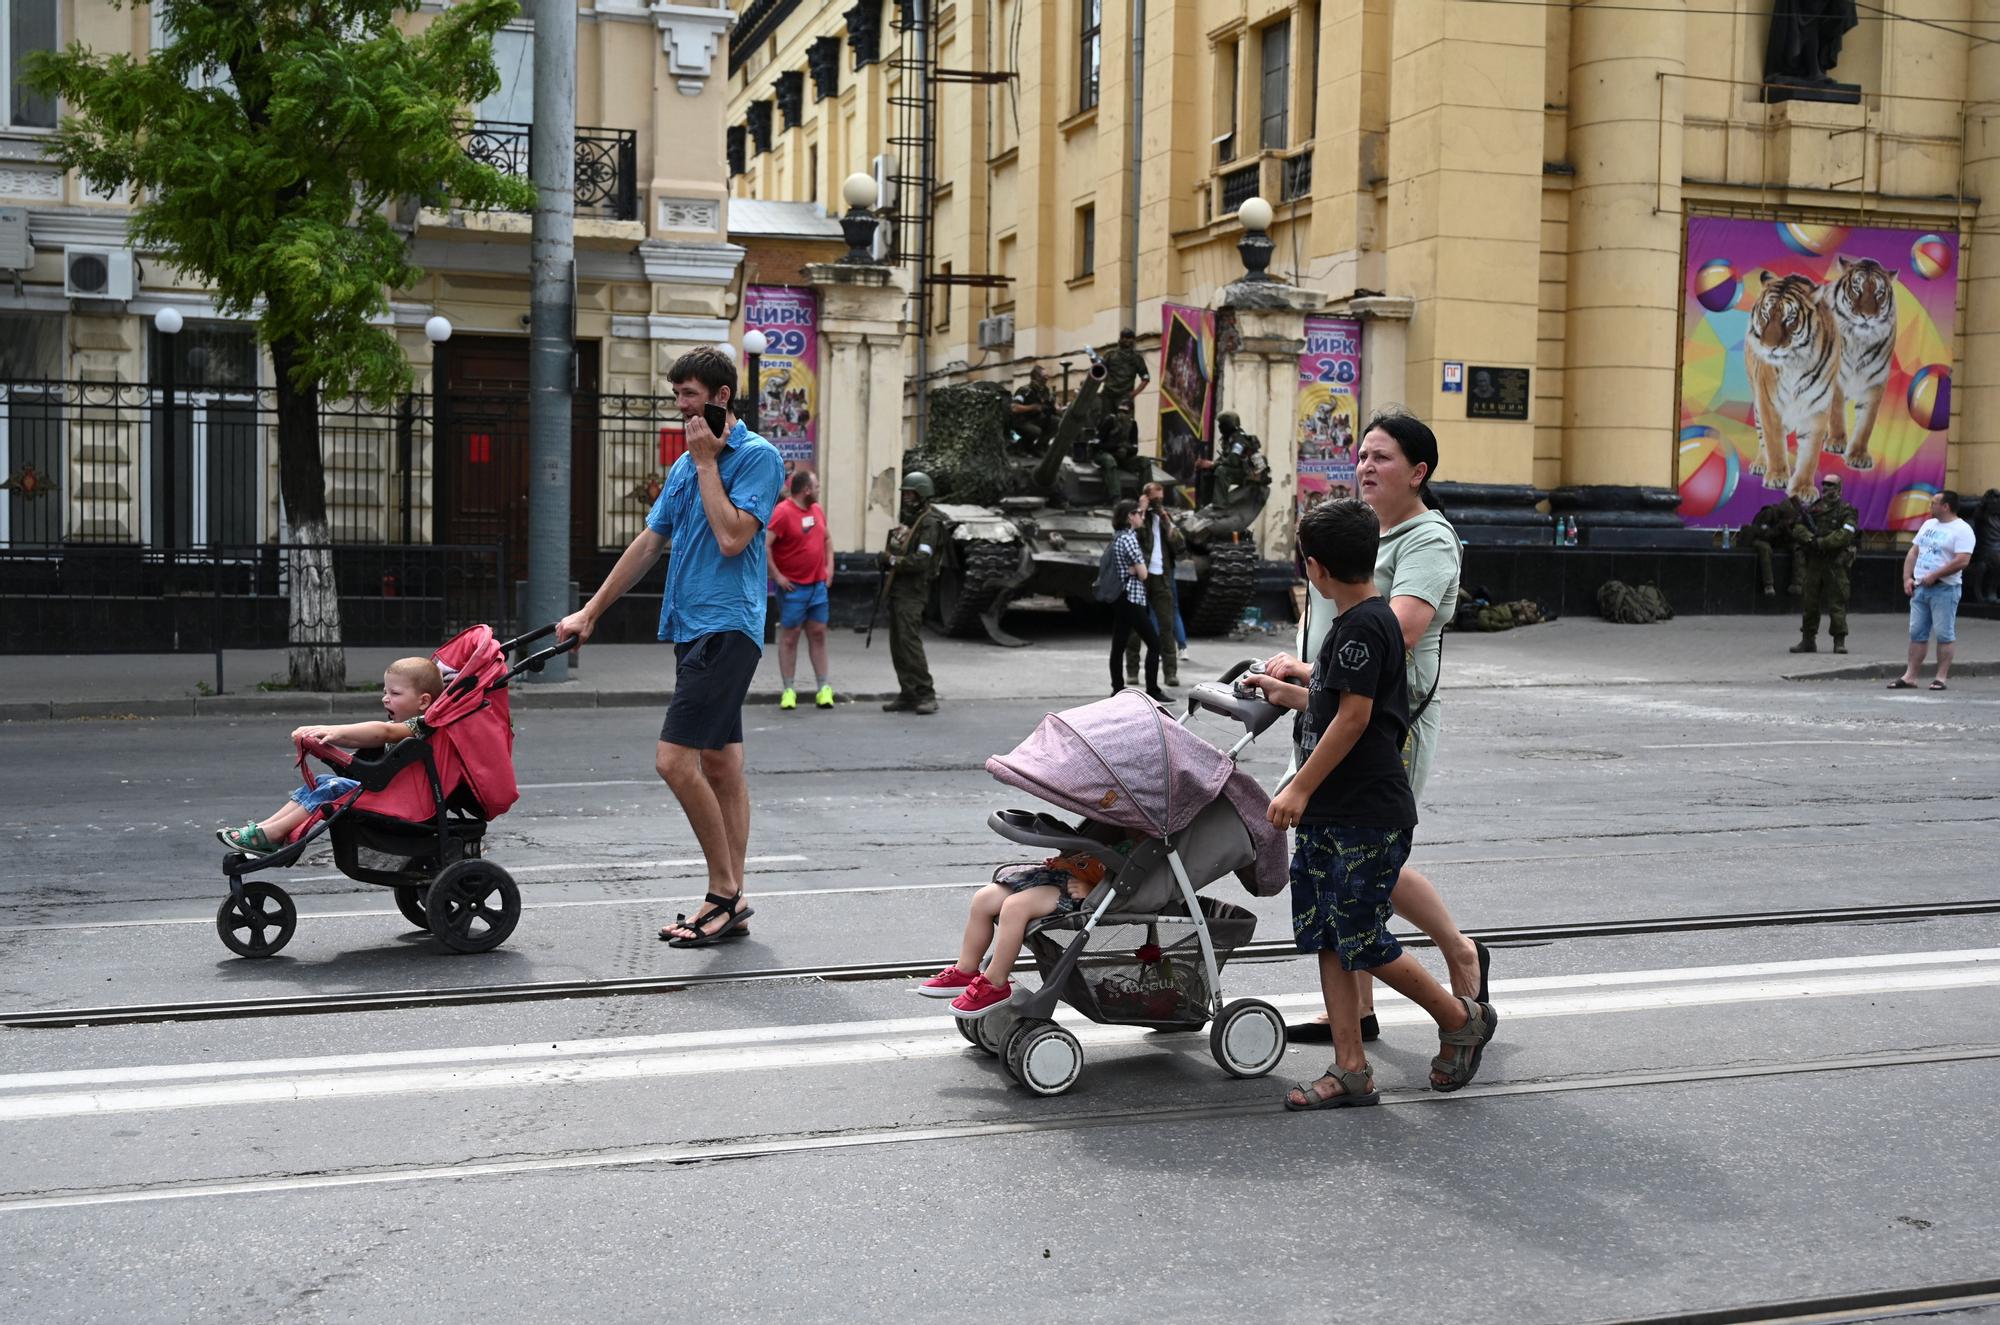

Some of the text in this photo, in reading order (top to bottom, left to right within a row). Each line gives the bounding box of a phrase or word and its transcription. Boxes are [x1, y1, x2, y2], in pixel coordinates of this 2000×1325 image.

[745, 305, 812, 328] ЦИРК
[763, 329, 806, 357] 29
[1318, 359, 1355, 383] 28
